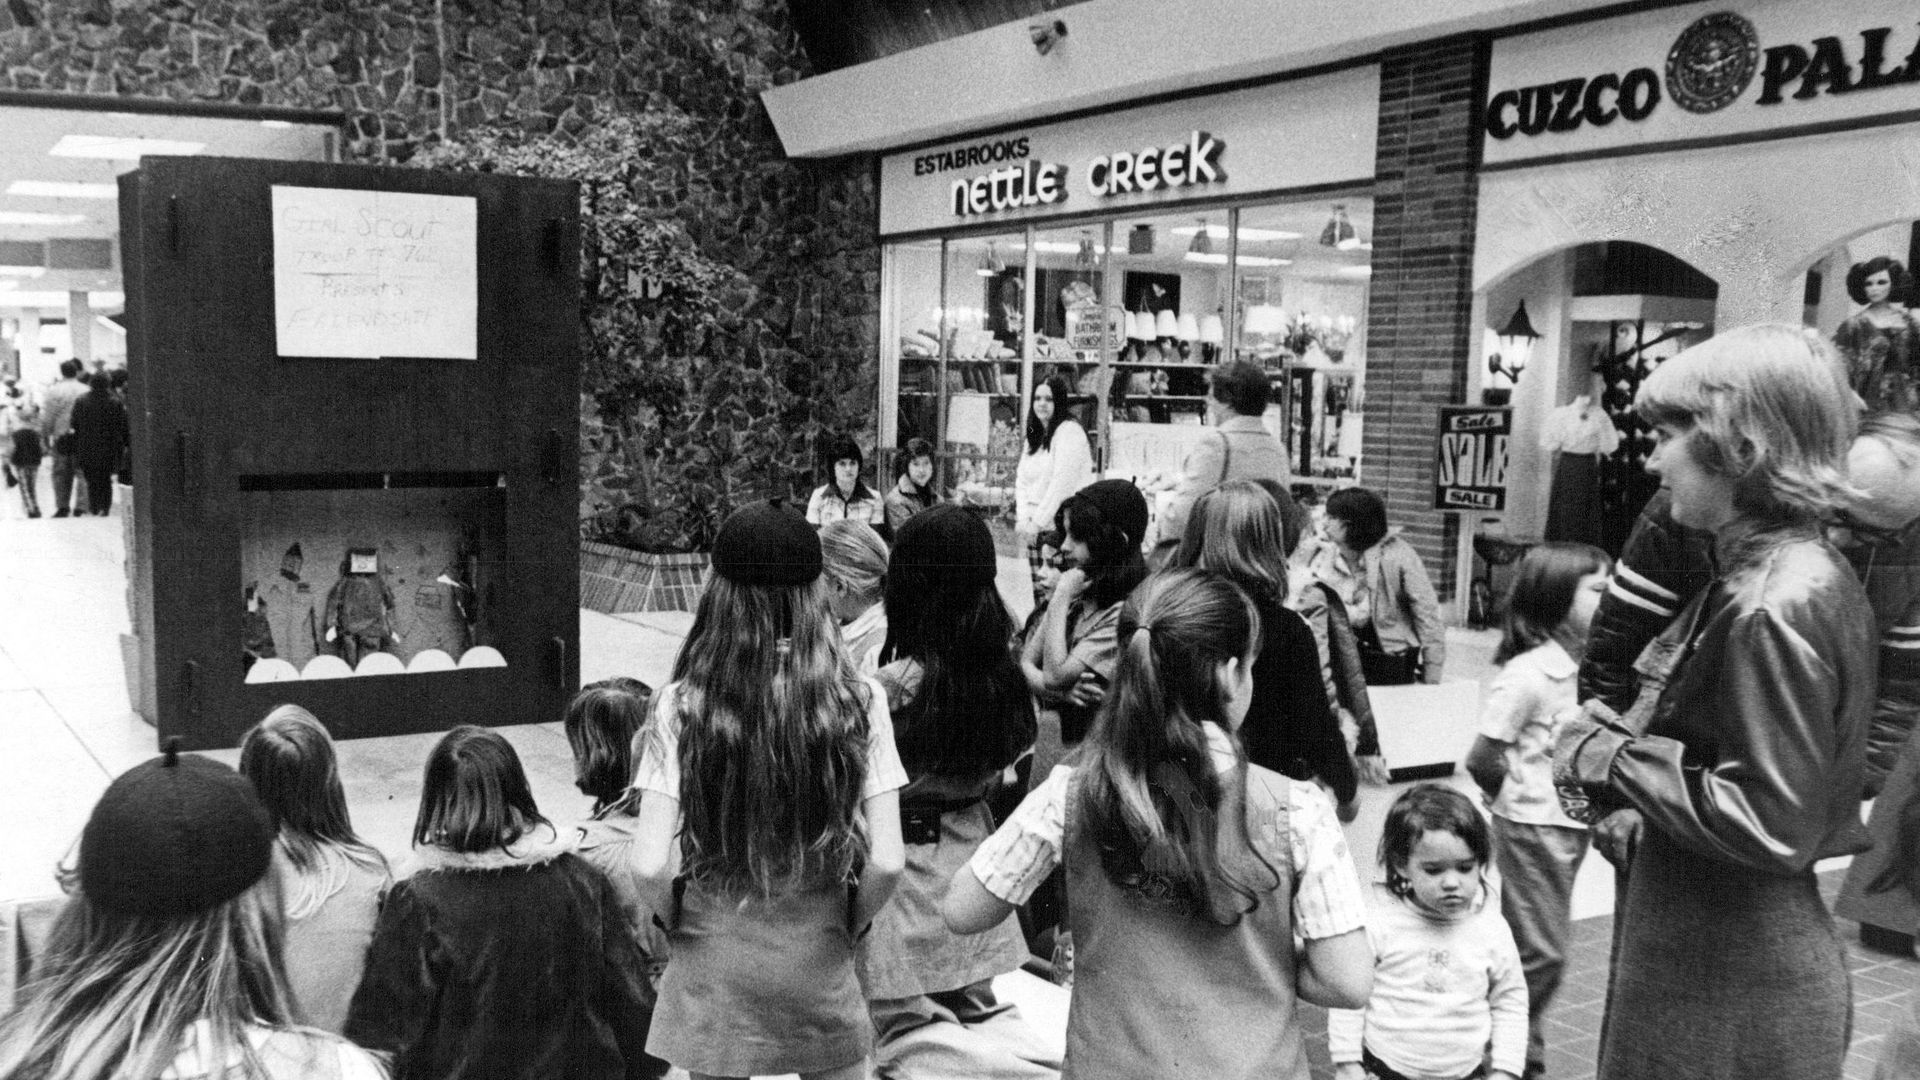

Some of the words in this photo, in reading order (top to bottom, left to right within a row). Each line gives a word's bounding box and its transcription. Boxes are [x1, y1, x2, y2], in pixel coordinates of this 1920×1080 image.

[1486, 66, 1661, 140] CUZCO
[915, 137, 1030, 176] ESTABROOKS
[1456, 413, 1495, 429] Sale
[1439, 433, 1509, 486] SALE
[1449, 491, 1492, 506] SALE
